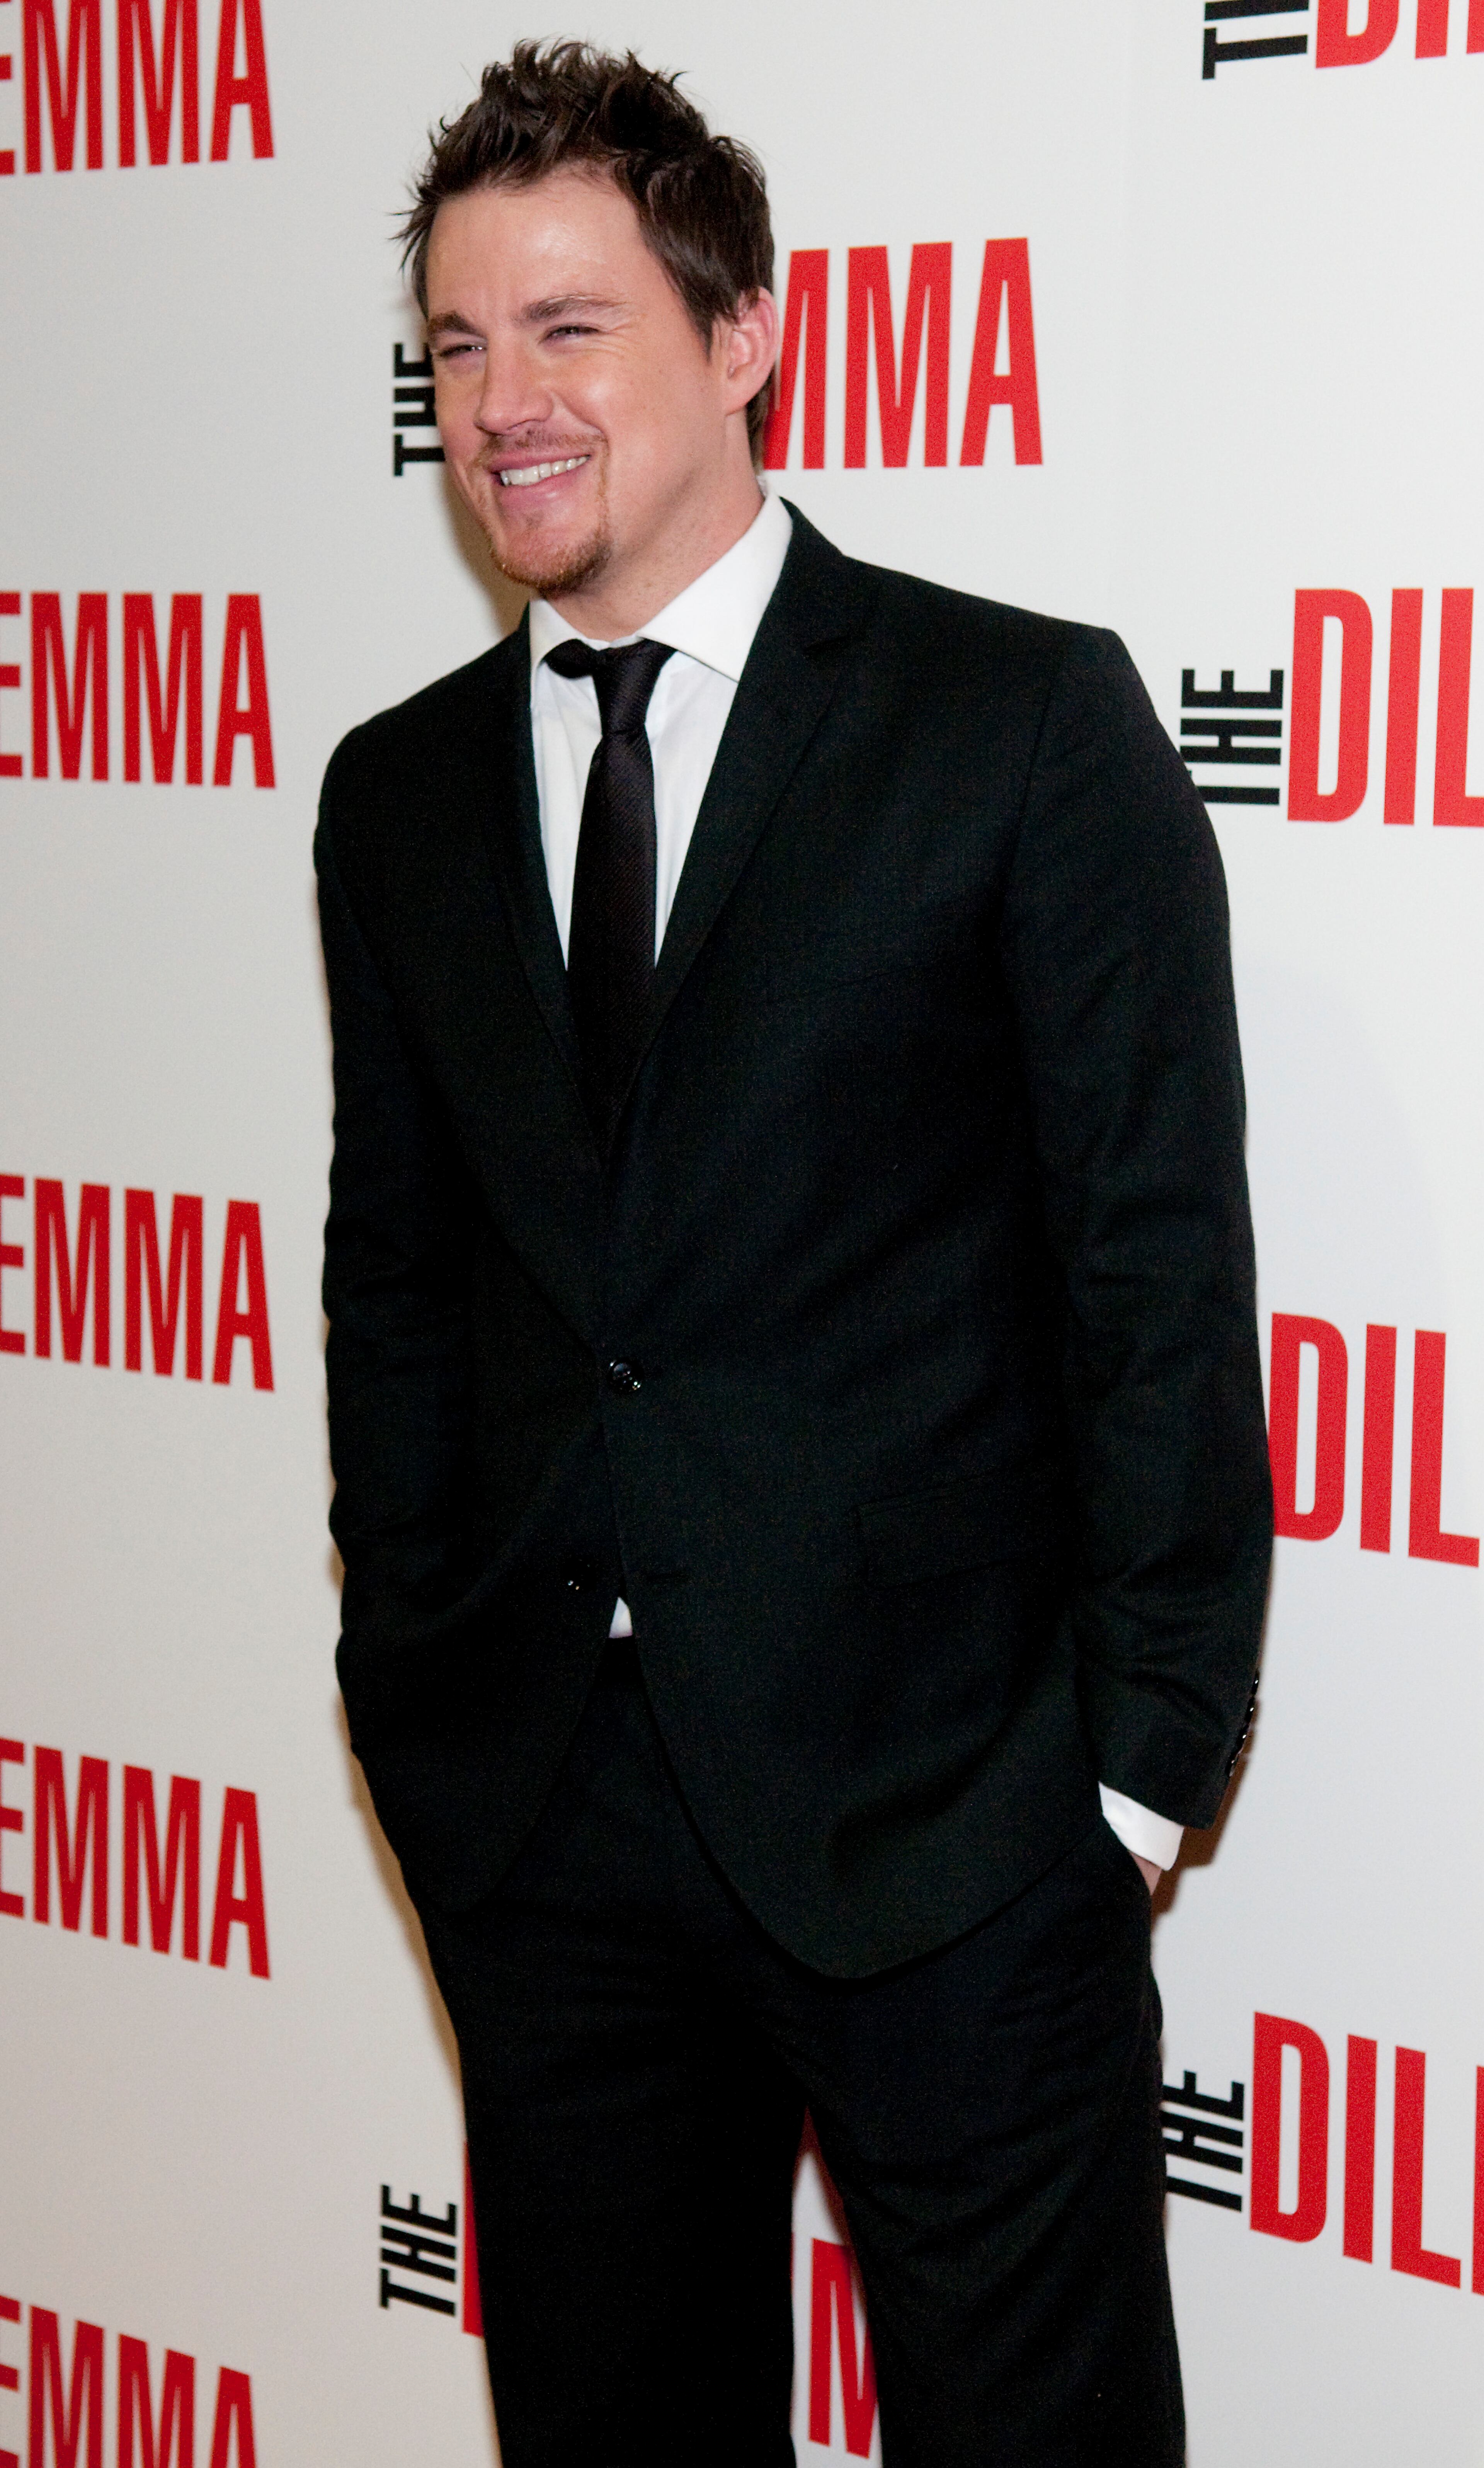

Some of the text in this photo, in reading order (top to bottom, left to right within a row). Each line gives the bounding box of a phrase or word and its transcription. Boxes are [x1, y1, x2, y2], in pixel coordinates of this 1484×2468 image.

[0, 0, 274, 175] MMA
[1288, 587, 1484, 827] DIL
[0, 1173, 274, 1392] EMMA
[1268, 1312, 1480, 1568] DIL
[0, 1736, 271, 1980] EMMA
[380, 2184, 457, 2317] THE
[1249, 2011, 1484, 2296] DIL
